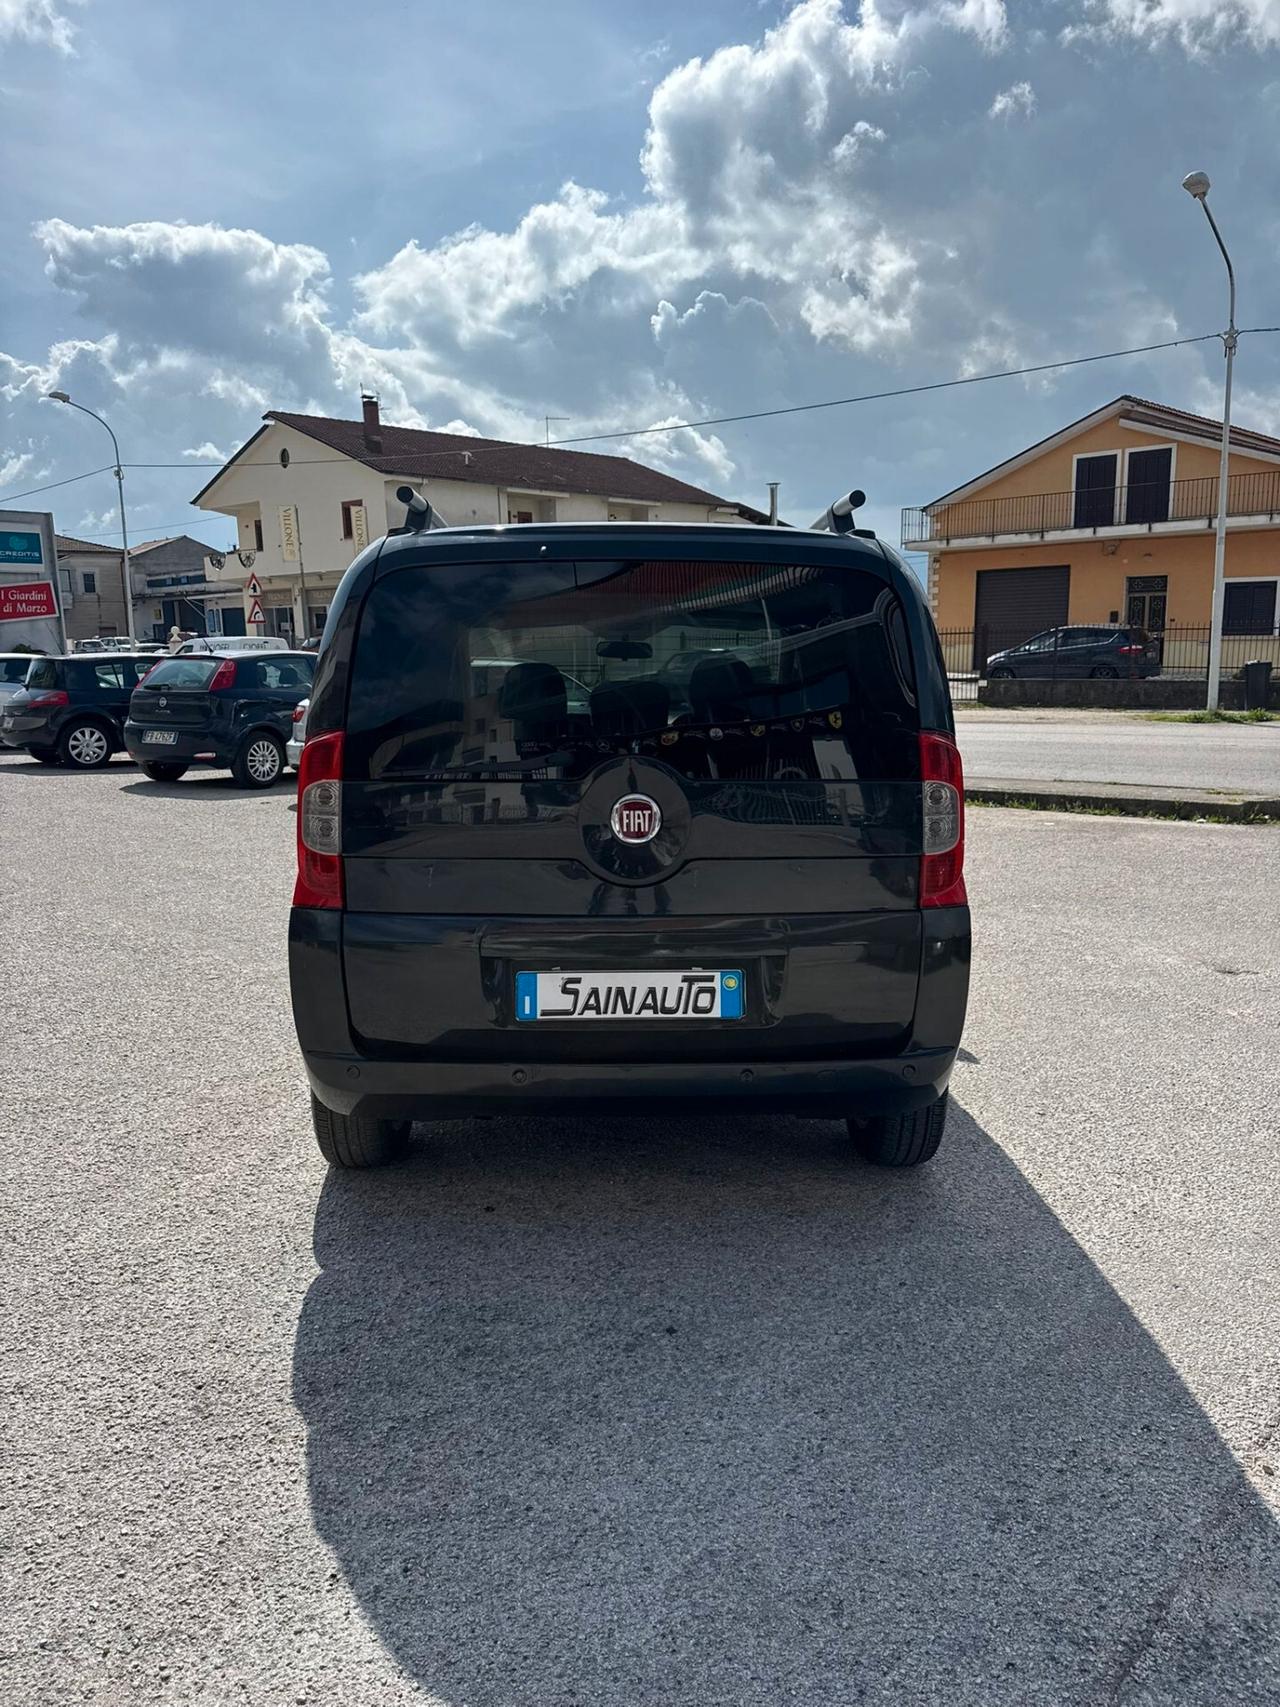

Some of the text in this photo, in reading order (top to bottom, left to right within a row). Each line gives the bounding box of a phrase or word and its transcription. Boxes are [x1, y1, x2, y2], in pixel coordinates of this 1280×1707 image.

[8, 590, 47, 601] Giardini
[3, 602, 47, 613] di Marzo
[622, 810, 651, 832] FIAT
